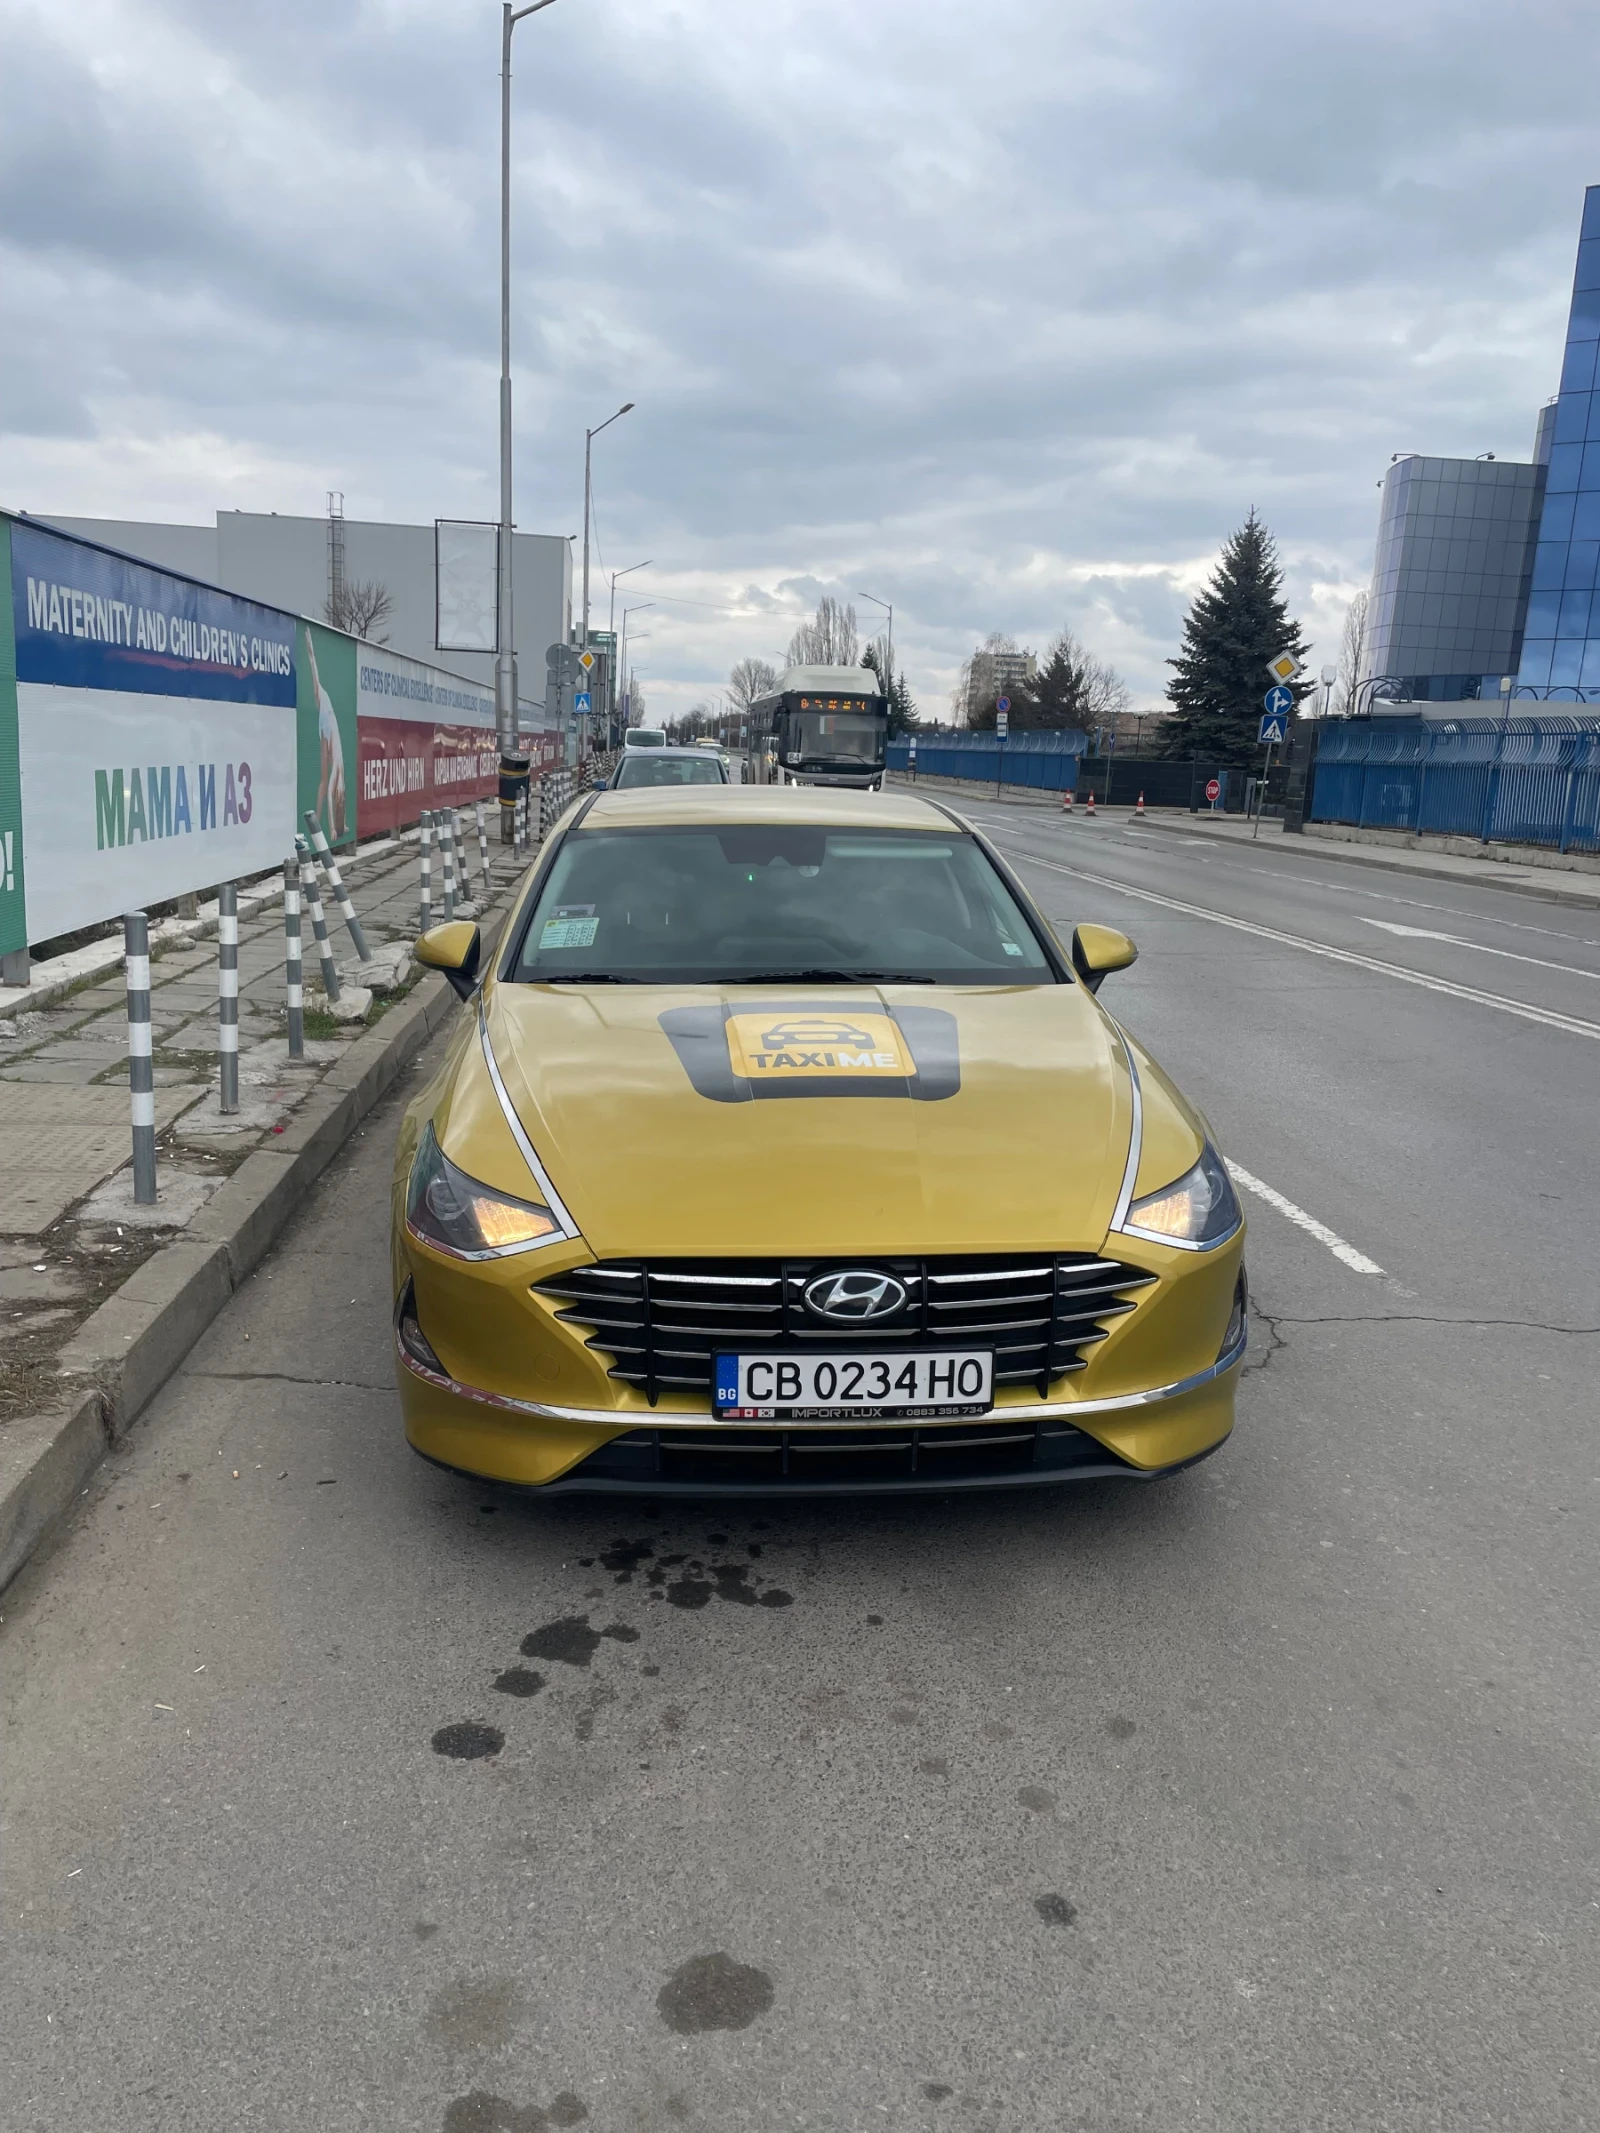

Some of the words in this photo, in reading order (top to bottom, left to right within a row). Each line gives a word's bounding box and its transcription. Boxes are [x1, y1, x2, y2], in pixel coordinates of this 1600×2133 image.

[27, 576, 133, 647] MATERNITY
[136, 607, 167, 653] AND
[170, 616, 248, 668] CHILDREN'S
[251, 637, 290, 676] CLINICS
[360, 666, 383, 694] CENTERS
[364, 759, 388, 801] HERZ
[389, 758, 407, 796] UND
[407, 757, 425, 792] HIRN
[1208, 786, 1218, 794] STOP
[95, 765, 192, 850] МАМА
[199, 764, 216, 830] И
[718, 1388, 736, 1400] BG
[747, 1362, 802, 1401] CB
[814, 1360, 918, 1400] 0234
[928, 1358, 983, 1399] HO
[791, 1408, 882, 1419] IMPORTLUX
[906, 1408, 935, 1417] 0883
[938, 1407, 959, 1415] 356
[962, 1405, 983, 1414] 734
